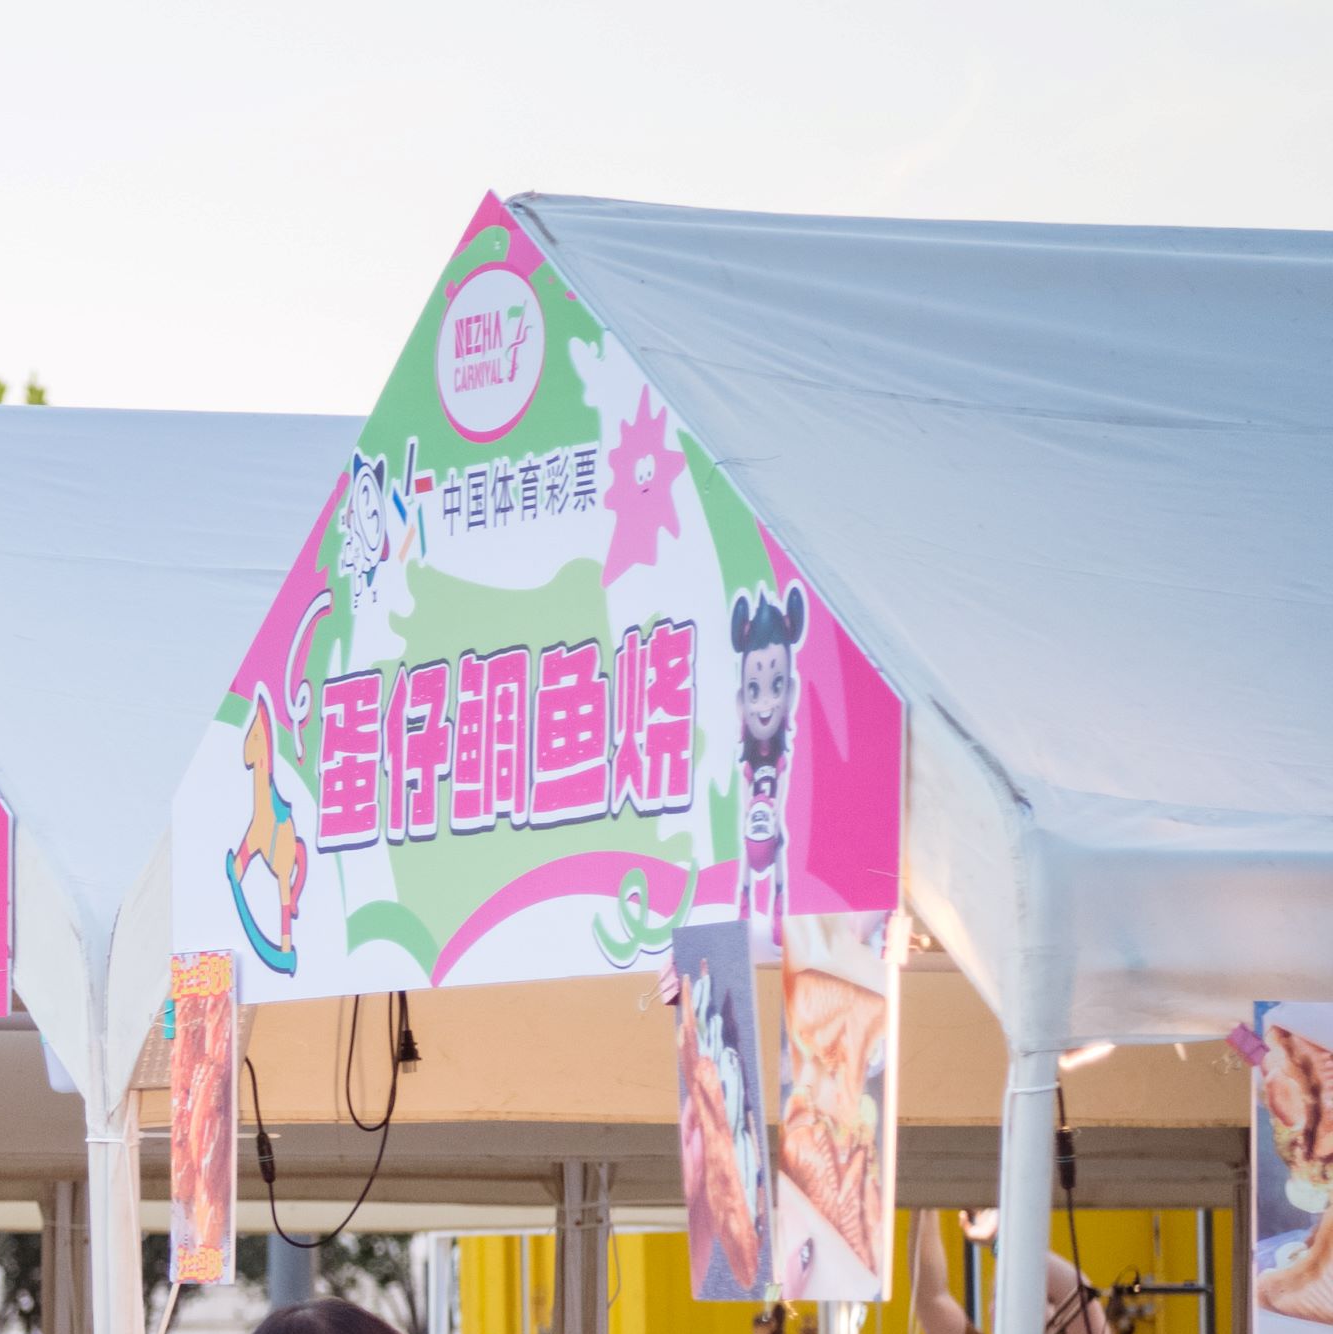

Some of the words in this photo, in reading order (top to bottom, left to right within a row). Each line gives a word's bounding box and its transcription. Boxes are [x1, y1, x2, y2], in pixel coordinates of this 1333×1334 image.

[454, 310, 503, 360] NEZHA
[442, 447, 598, 537] 中国体育彩票
[317, 623, 695, 848] 蛋仔鲷鱼烧
